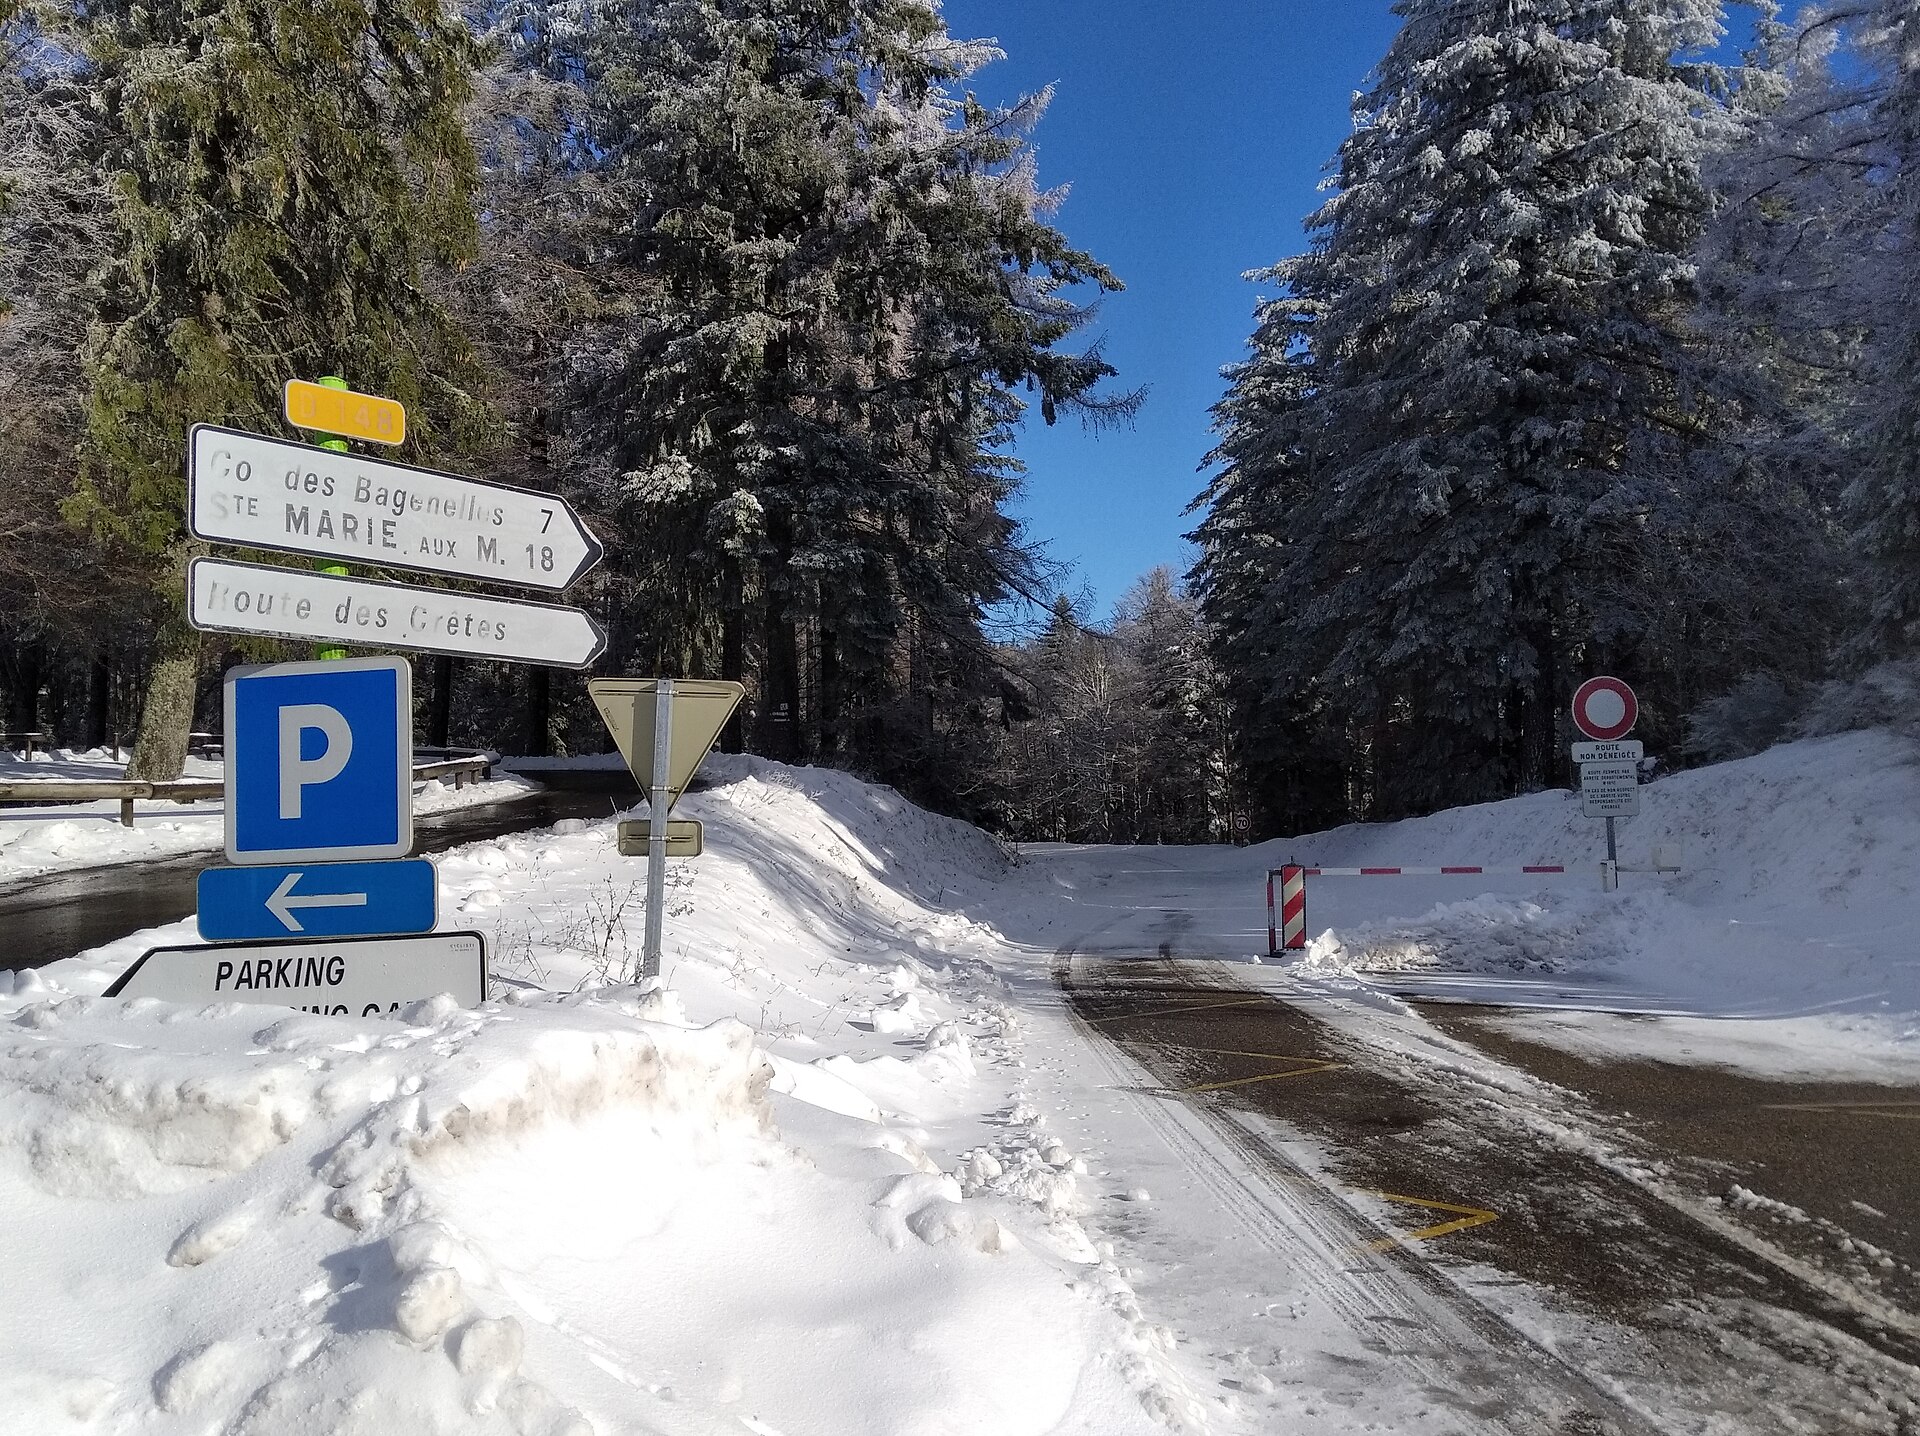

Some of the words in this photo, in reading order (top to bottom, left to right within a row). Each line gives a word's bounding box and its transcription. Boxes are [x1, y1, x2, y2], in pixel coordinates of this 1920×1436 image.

[300, 391, 316, 418] D
[338, 399, 392, 435] 148
[210, 490, 259, 521] STE
[285, 503, 397, 549] MARIE
[419, 535, 458, 559] AUX
[477, 535, 505, 565] M.
[525, 543, 555, 572] 18
[284, 464, 336, 497] des
[540, 508, 554, 535] 7
[207, 578, 312, 620] Route
[334, 594, 389, 629] des
[409, 604, 507, 641] Crêtes
[278, 703, 354, 820] P
[1237, 819, 1248, 828] 70
[215, 955, 346, 992] PARKING
